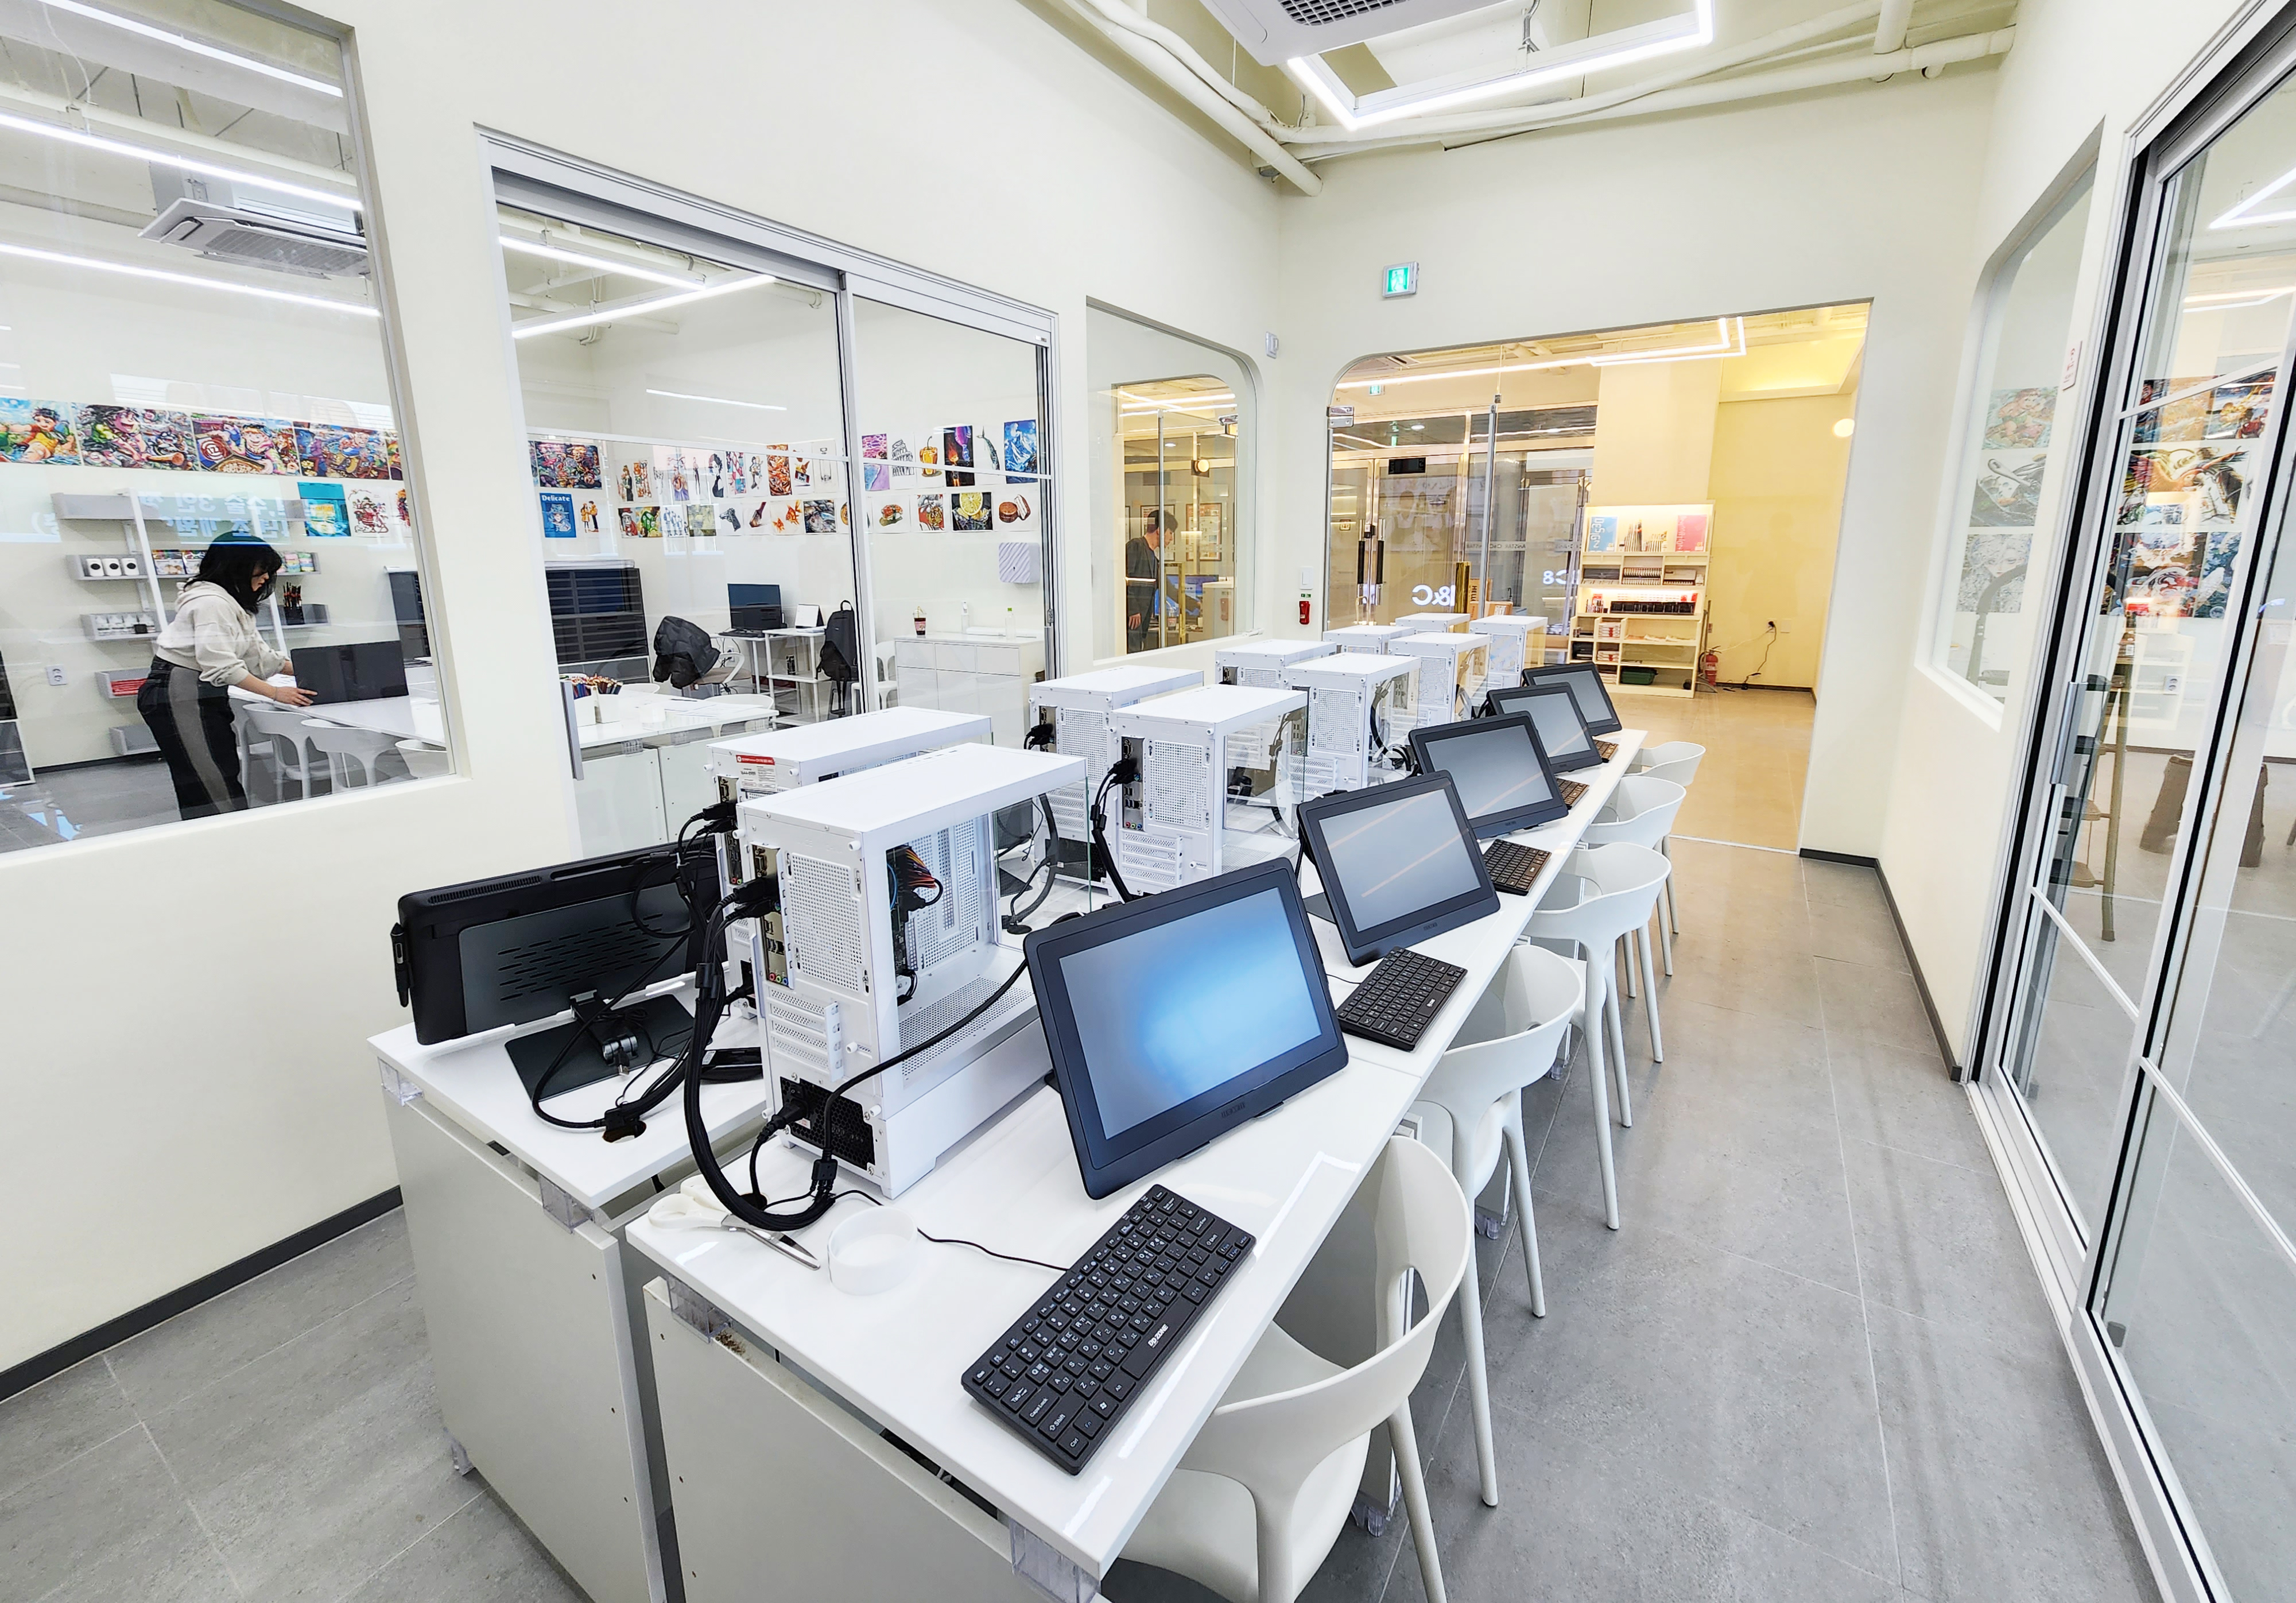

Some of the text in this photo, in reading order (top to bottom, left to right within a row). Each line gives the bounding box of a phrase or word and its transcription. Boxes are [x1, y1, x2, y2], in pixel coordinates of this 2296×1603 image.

[1011, 1394, 1021, 1403] Tab
[1039, 1398, 1048, 1408] Lock
[1054, 1414, 1066, 1426] Shift
[1070, 1438, 1079, 1447] Ctrl
